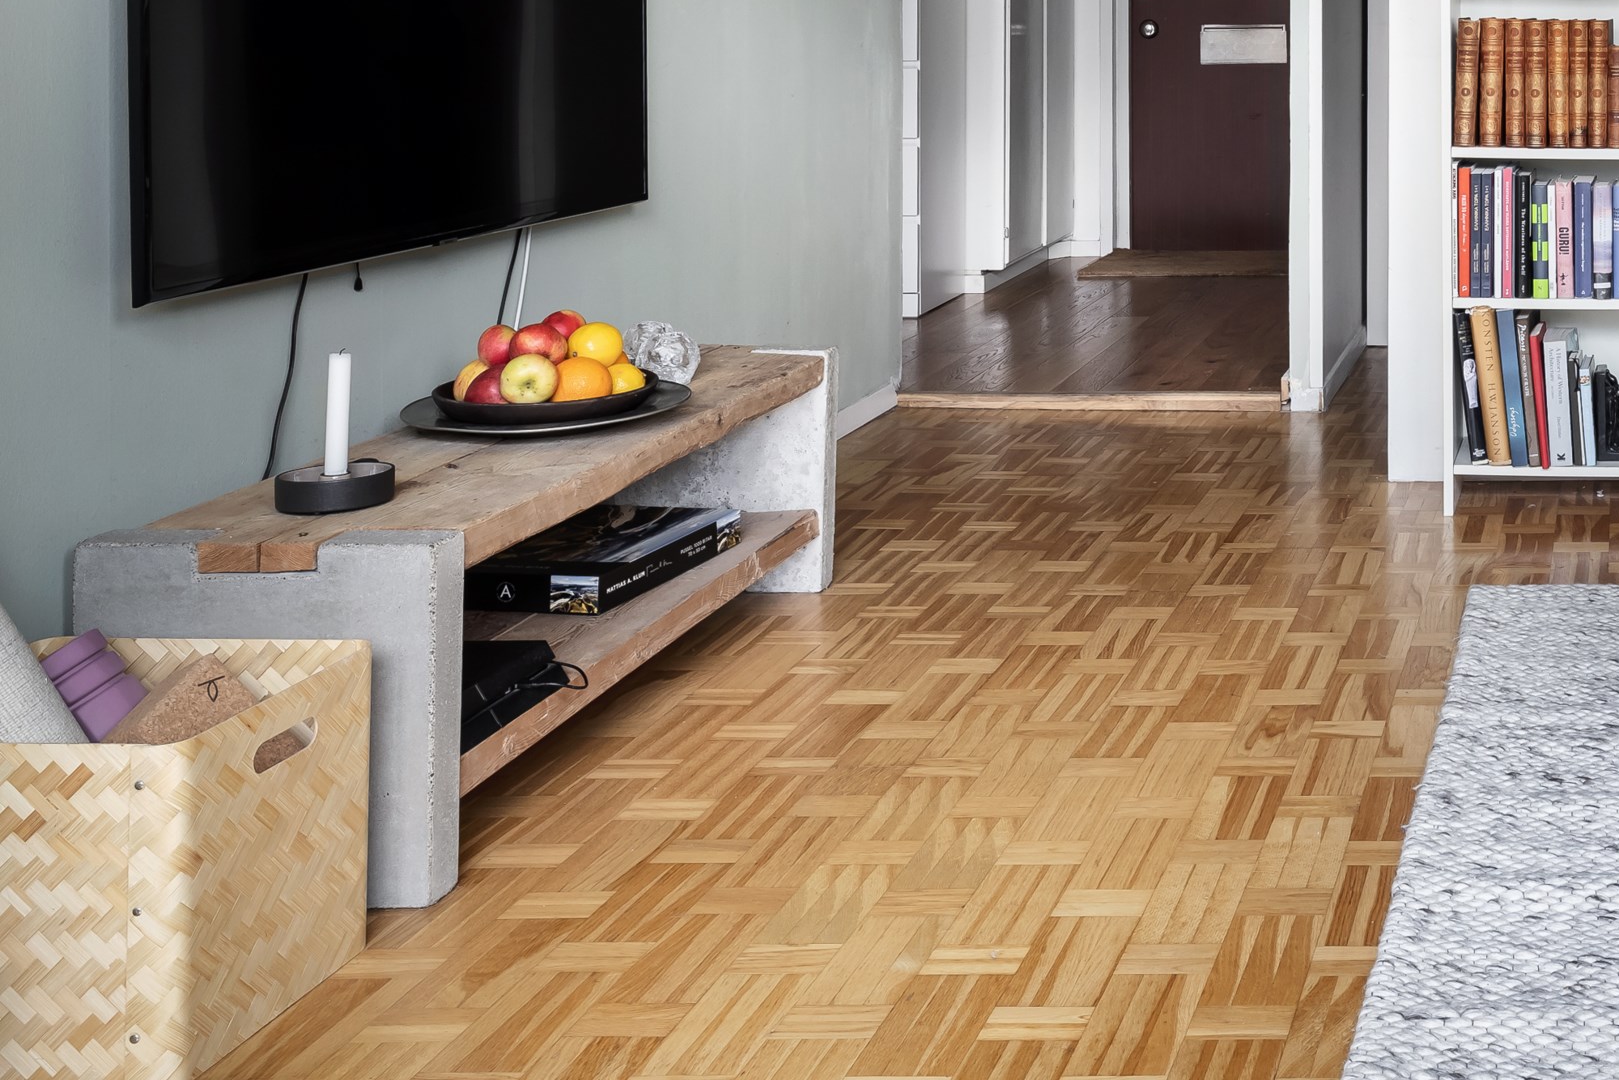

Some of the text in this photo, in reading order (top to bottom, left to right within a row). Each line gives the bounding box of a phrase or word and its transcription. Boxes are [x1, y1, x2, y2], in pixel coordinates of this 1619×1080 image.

[1558, 226, 1570, 255] GURU!
[1481, 310, 1494, 372] KONSTEN
[1517, 324, 1527, 352] Picasso
[1548, 347, 1557, 382] Architecture
[680, 535, 713, 555] PUSSEL 1000 BITAR
[606, 578, 627, 595] MATTIAS
[632, 570, 646, 582] KLUM
